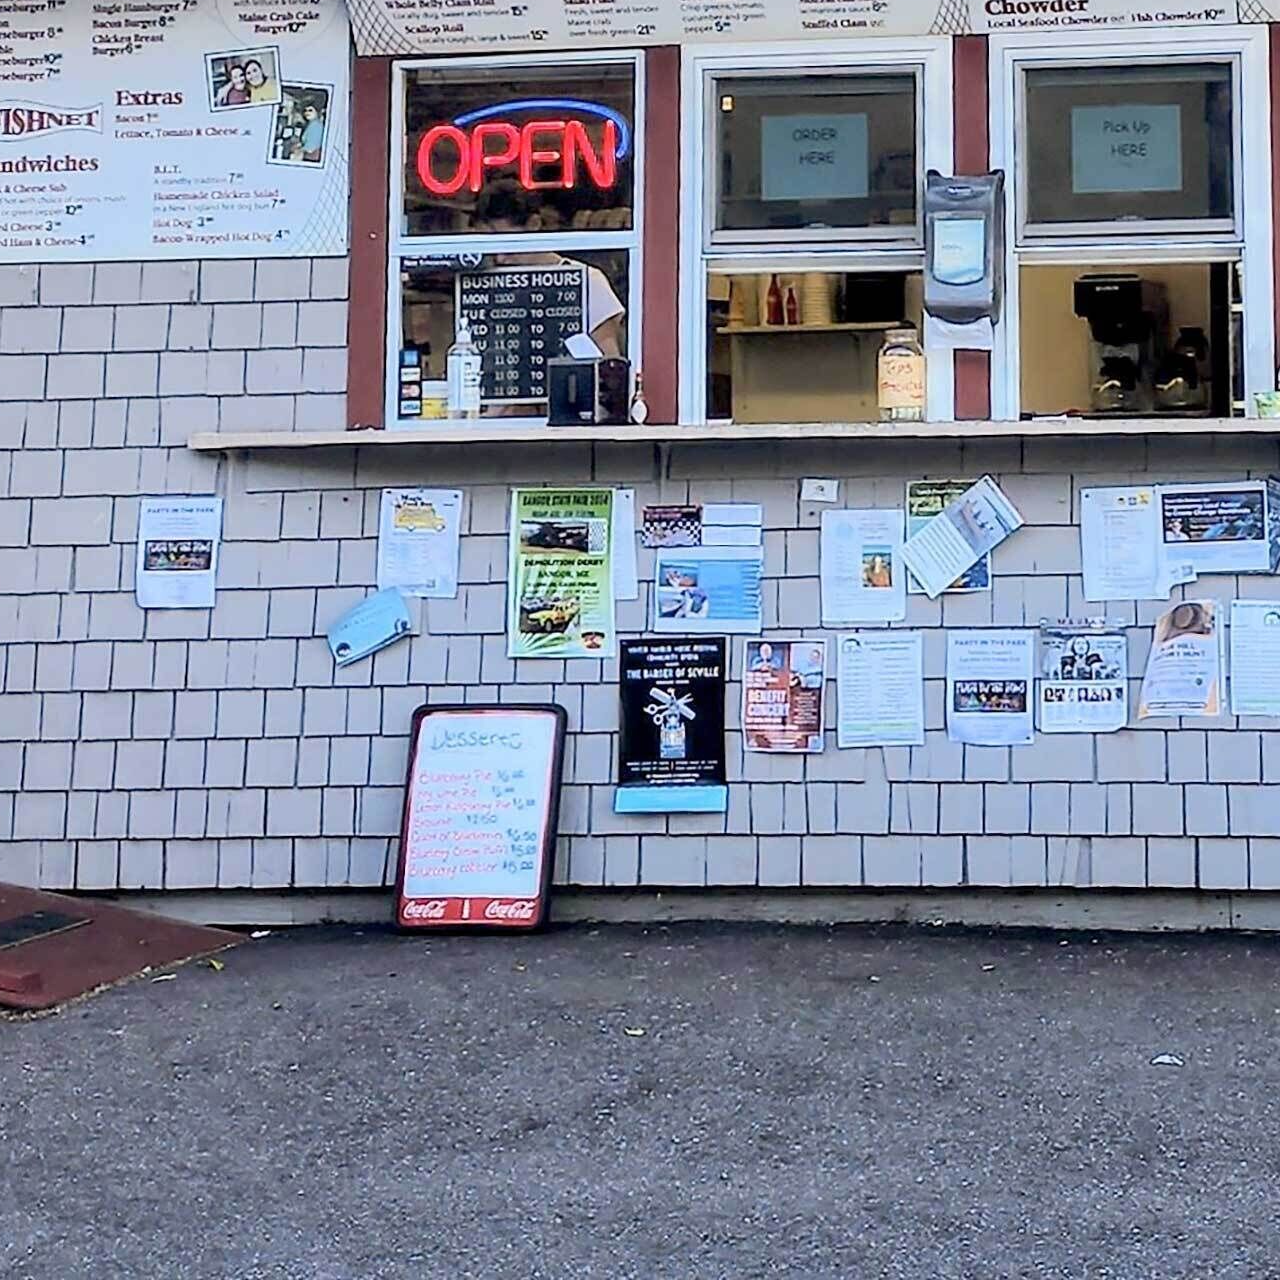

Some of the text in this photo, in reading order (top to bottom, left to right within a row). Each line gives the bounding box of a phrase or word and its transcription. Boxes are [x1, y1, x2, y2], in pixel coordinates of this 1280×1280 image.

[115, 90, 183, 106] Extras
[791, 128, 839, 142] ORDER
[1111, 142, 1148, 157] HERE
[417, 118, 617, 196] OPEN
[798, 150, 836, 165] HERE
[462, 271, 582, 290] BUSINESS HOURS
[462, 293, 545, 305] MON TO
[489, 307, 527, 319] CLOSED
[530, 308, 545, 319] TO
[545, 306, 583, 318] CLOSED
[530, 323, 545, 334] TO
[530, 338, 545, 350] TO
[530, 354, 545, 365] TO
[530, 370, 545, 381] TO
[530, 386, 545, 397] TO
